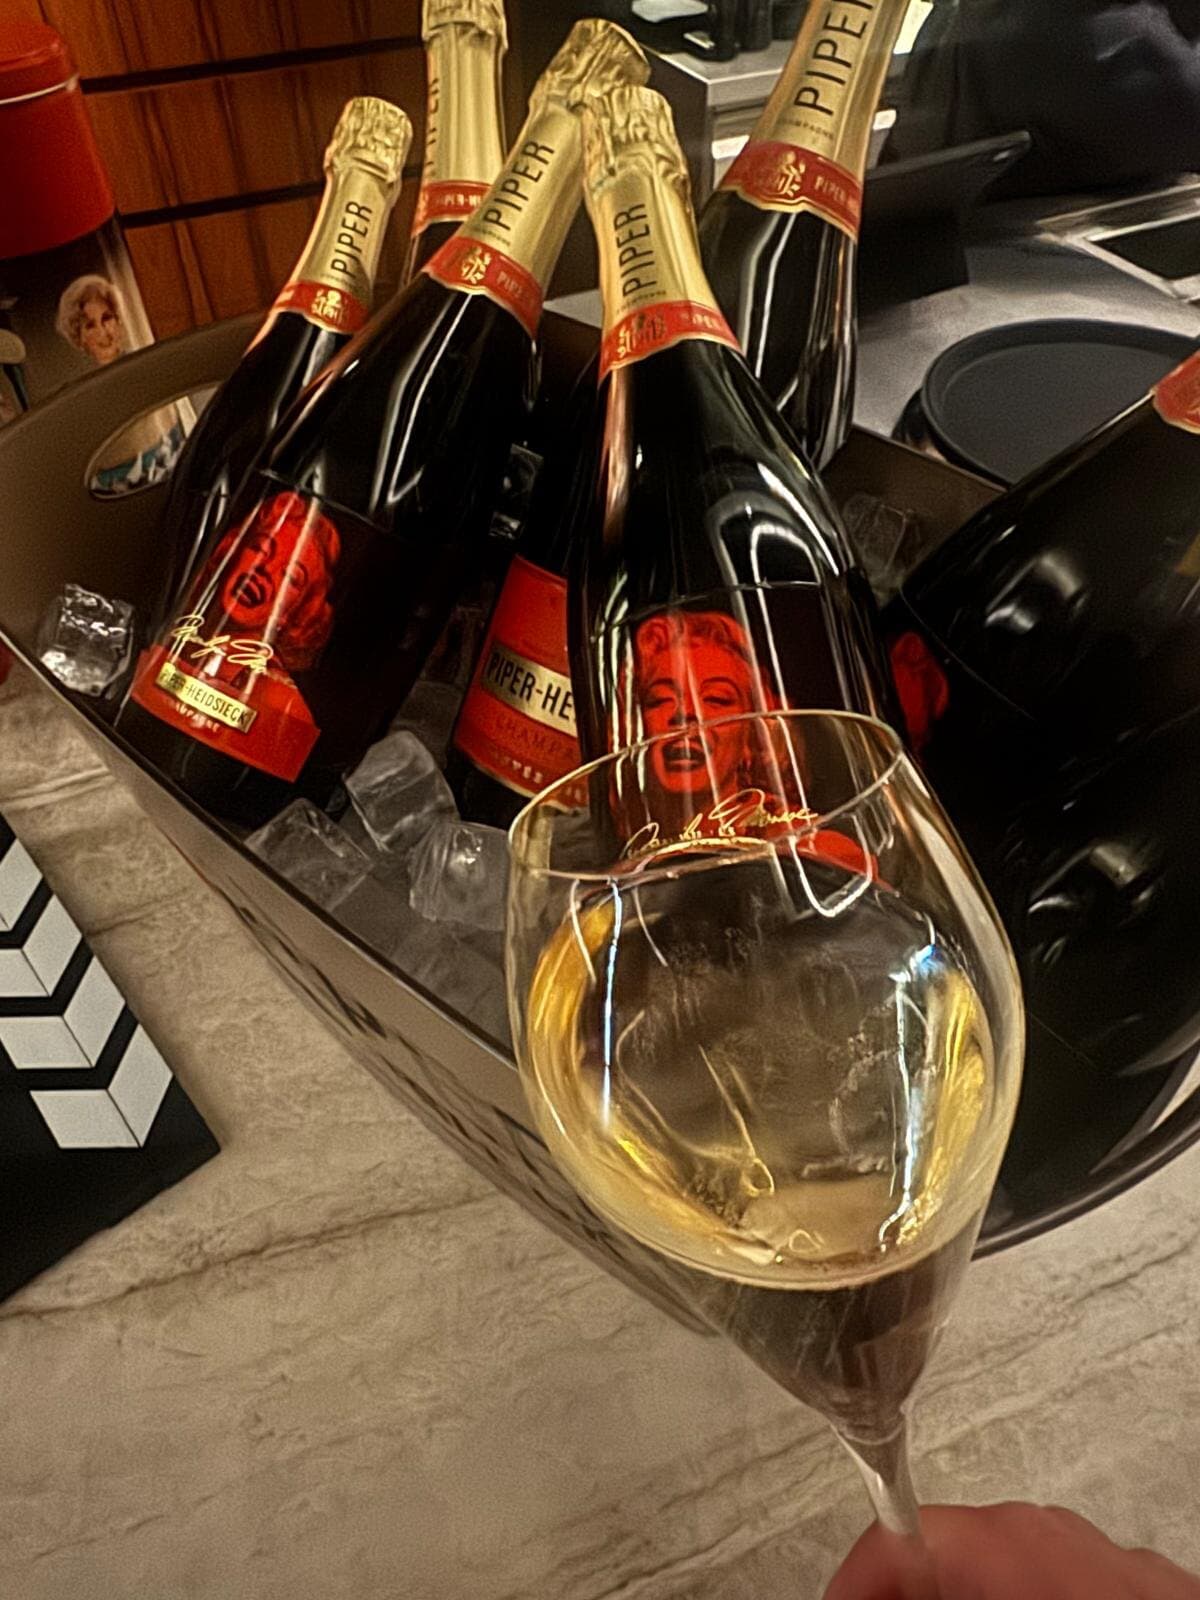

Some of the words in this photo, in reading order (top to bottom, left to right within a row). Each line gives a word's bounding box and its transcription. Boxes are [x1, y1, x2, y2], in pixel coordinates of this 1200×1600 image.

[483, 140, 555, 231] PIPER
[330, 201, 373, 279] PIPER
[613, 203, 657, 297] PIPER
[486, 651, 576, 721] PIPER-HE
